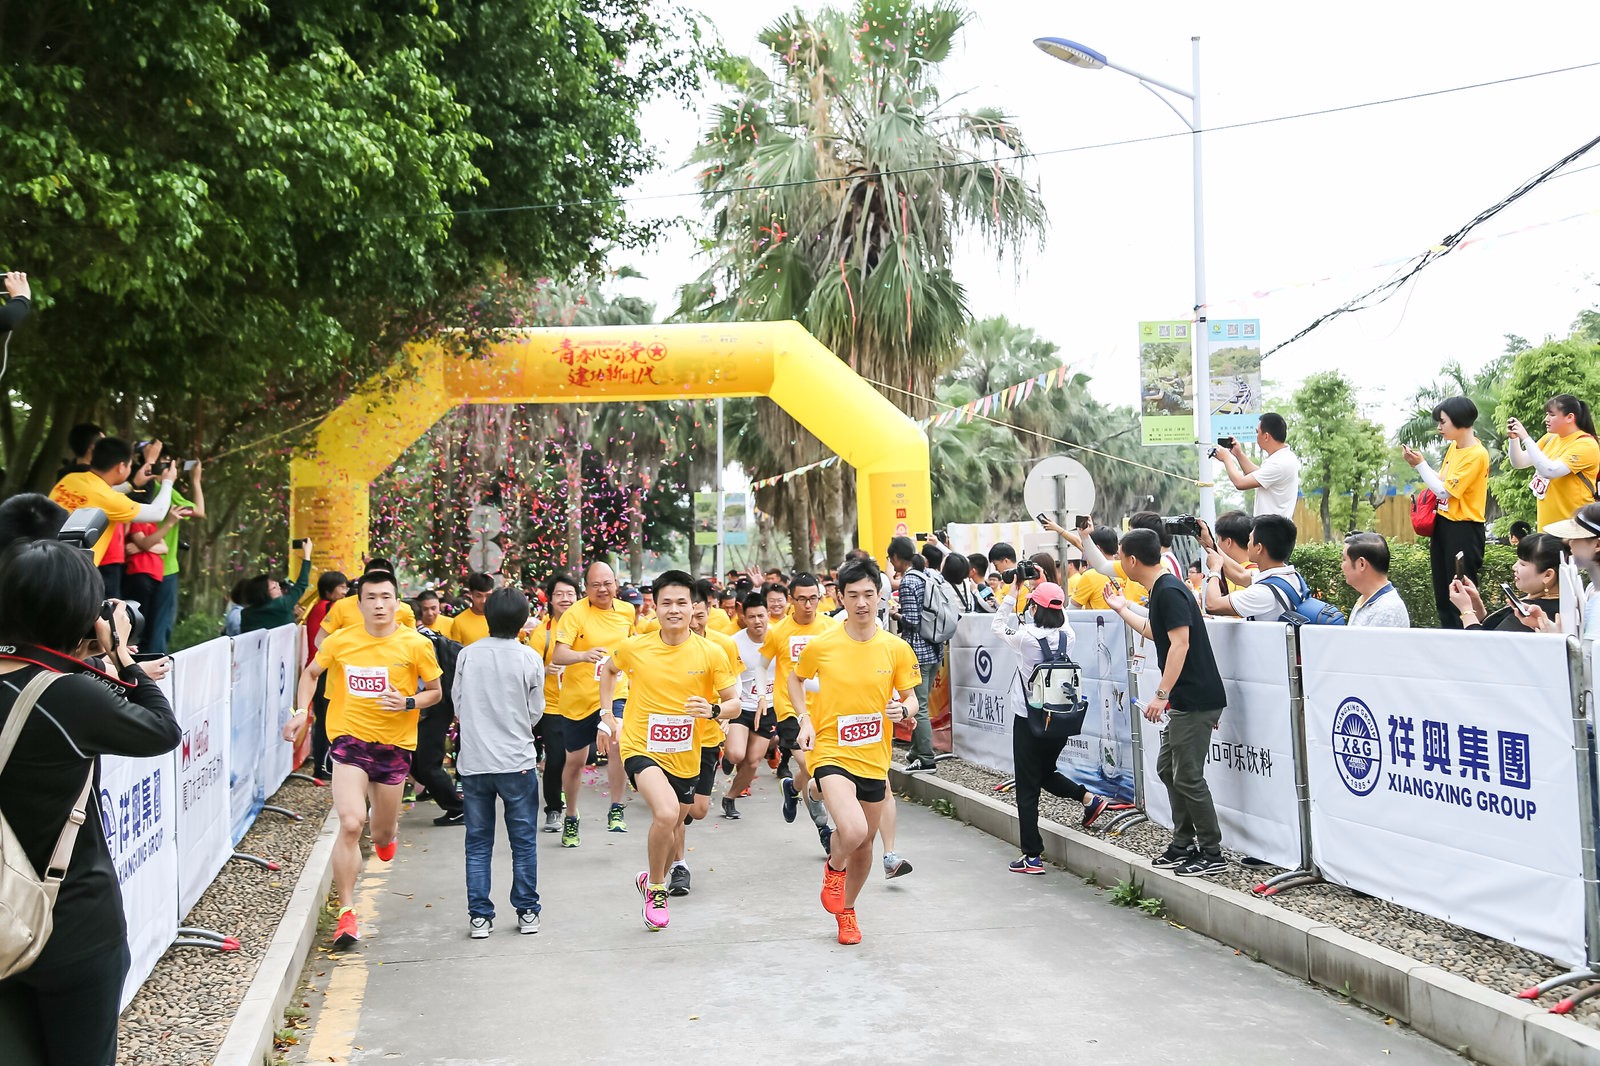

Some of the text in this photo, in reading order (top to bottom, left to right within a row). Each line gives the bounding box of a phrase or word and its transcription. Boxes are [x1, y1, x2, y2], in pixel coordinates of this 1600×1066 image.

[101, 678, 127, 695] EOS
[350, 677, 383, 691] 5085
[968, 692, 1004, 724] 兴业银行
[653, 726, 689, 741] 5338
[844, 722, 878, 741] 5339
[1342, 736, 1372, 757] X&G
[1388, 714, 1531, 790] 祥興集團
[1207, 742, 1272, 777] 口可乐饮料
[1388, 772, 1537, 822] XIANGXING GROUP
